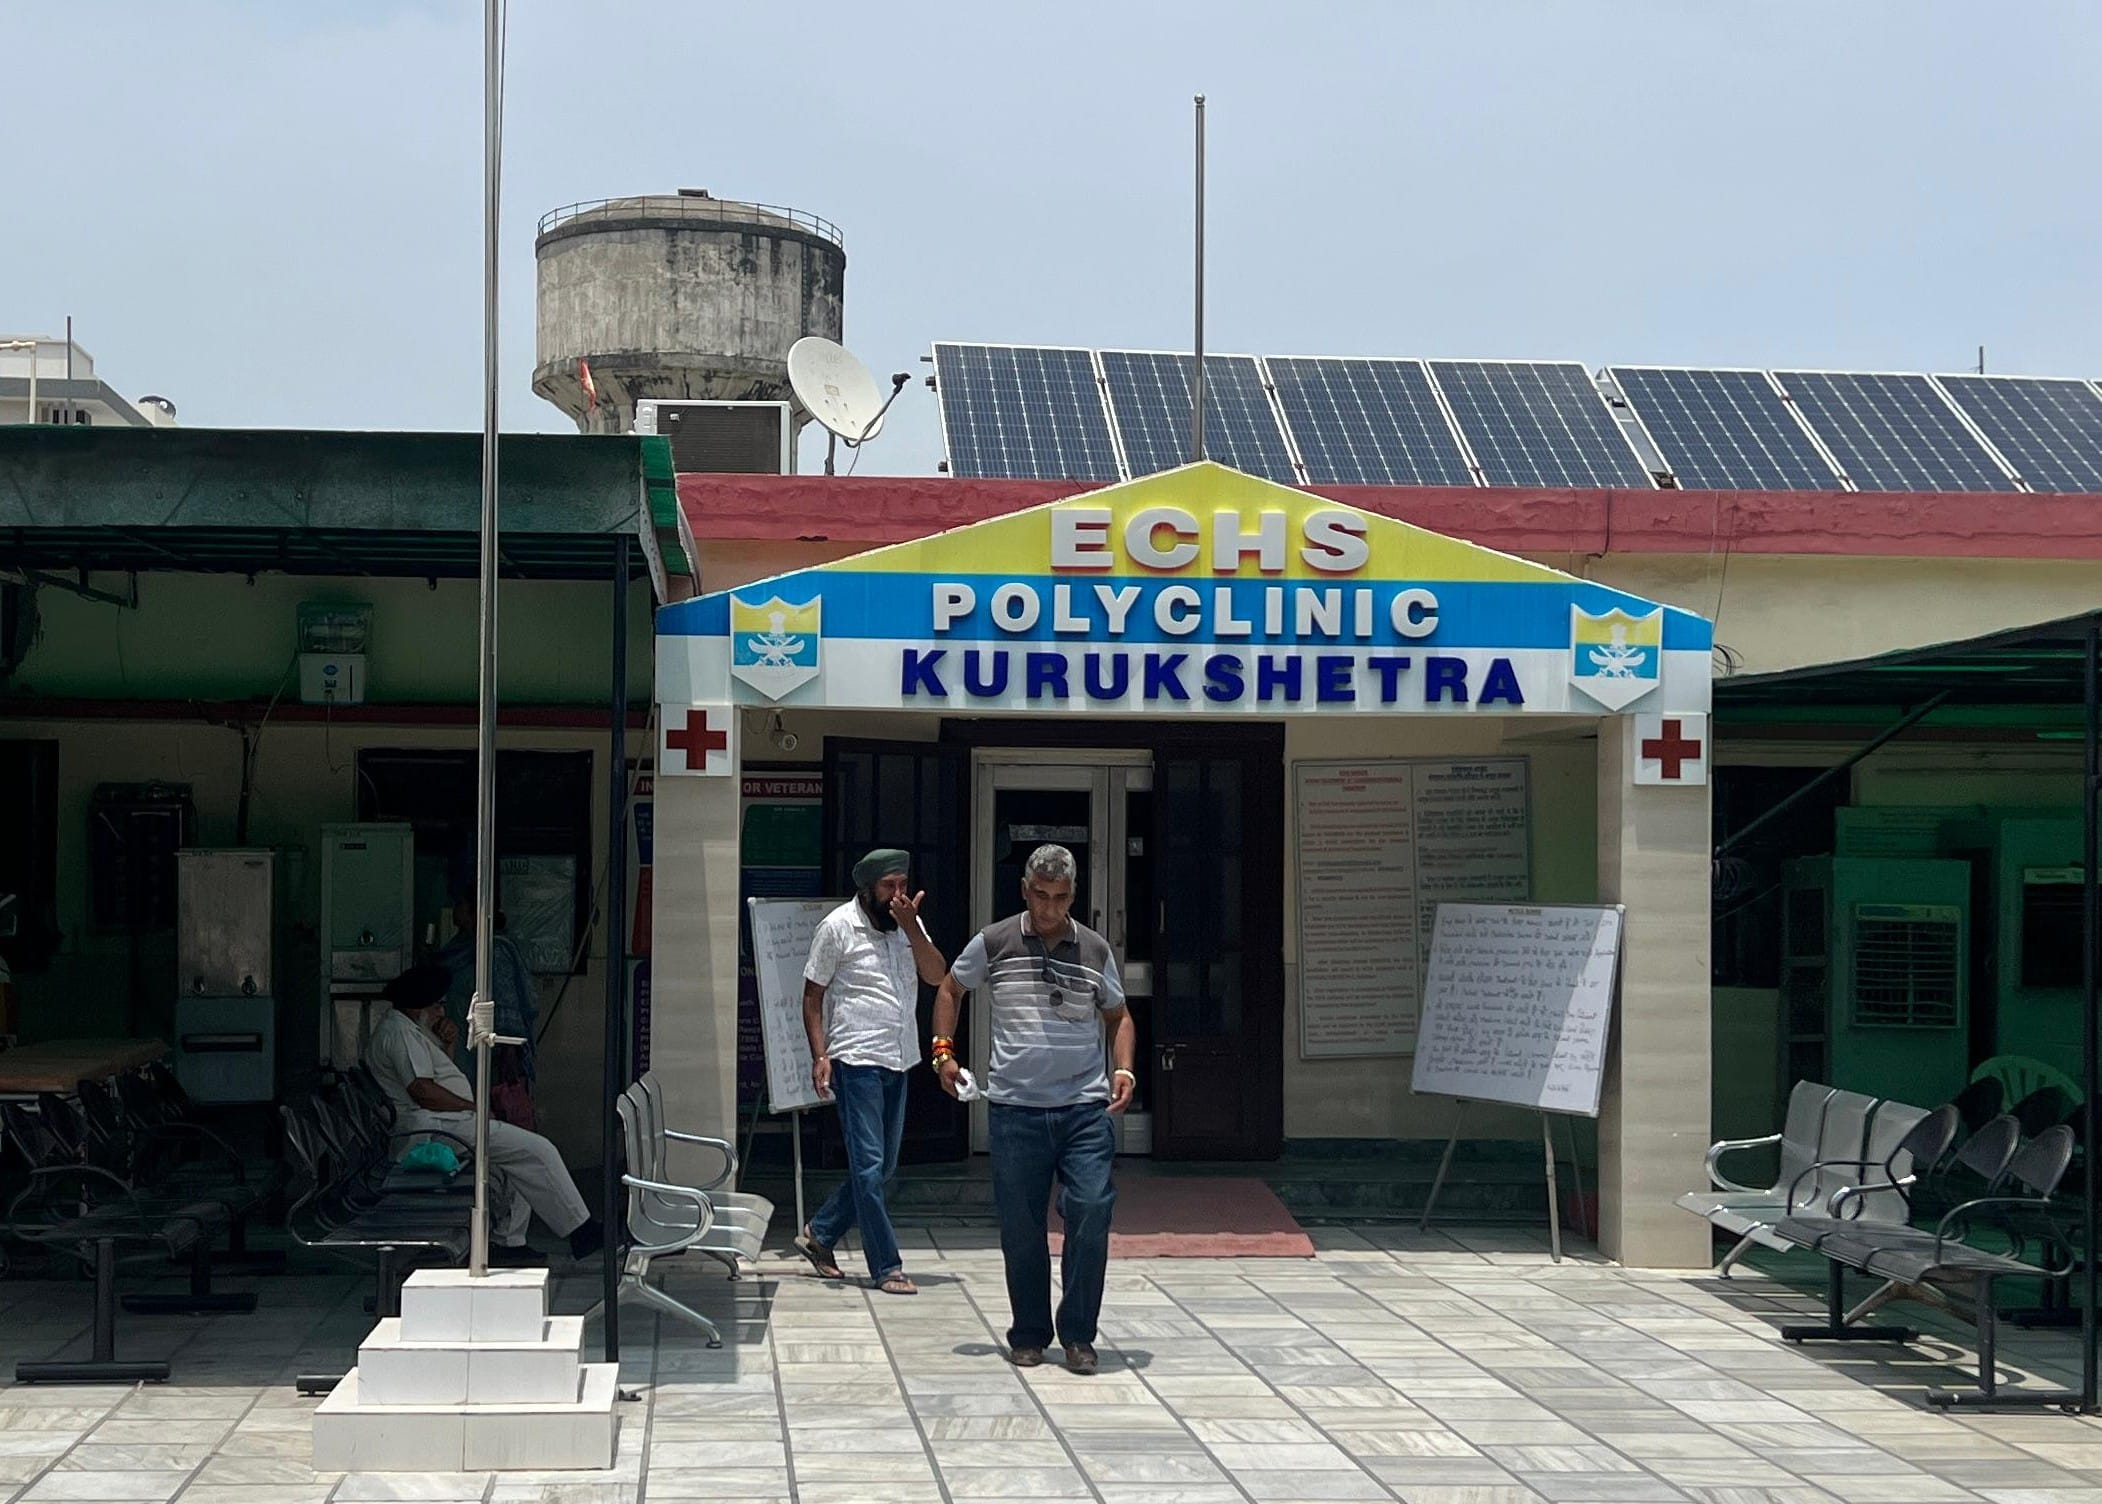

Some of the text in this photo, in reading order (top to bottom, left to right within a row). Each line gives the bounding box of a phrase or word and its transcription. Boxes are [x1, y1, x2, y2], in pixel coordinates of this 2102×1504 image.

[1051, 506, 1369, 572] ECHS
[932, 582, 1440, 639] POLYCLINIC
[901, 648, 1525, 705] KURUKSHETRA
[742, 782, 761, 794] OR
